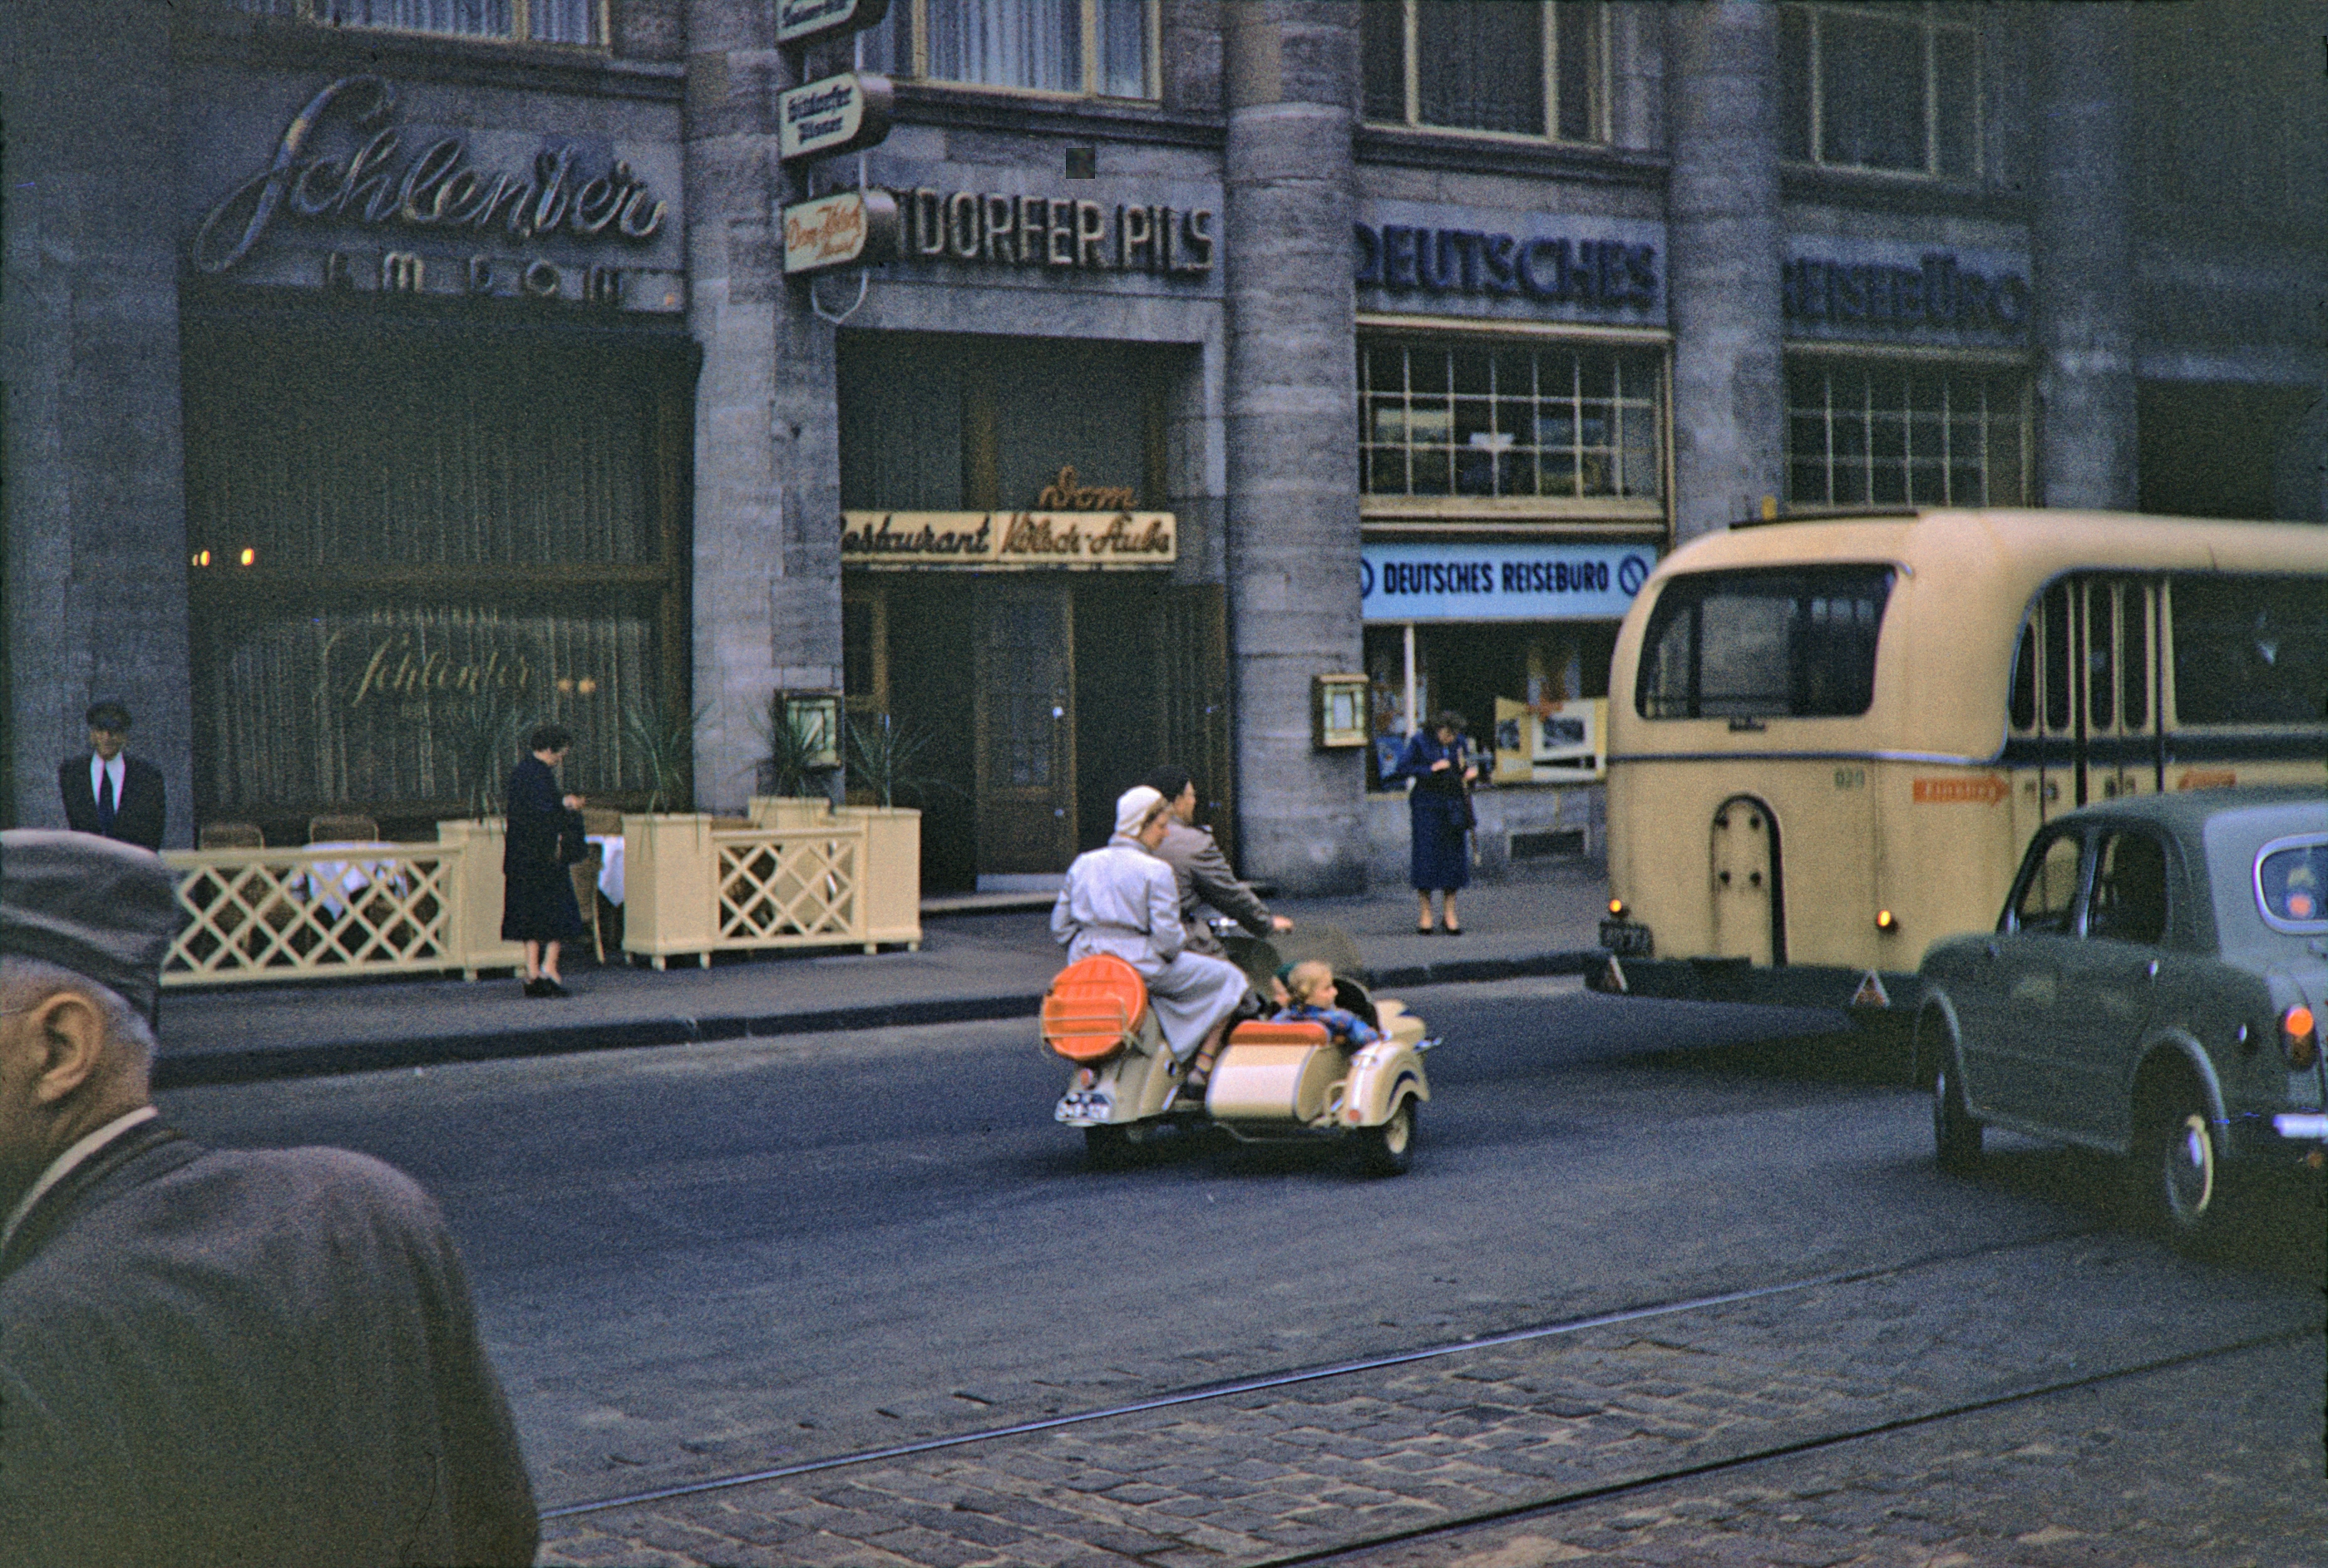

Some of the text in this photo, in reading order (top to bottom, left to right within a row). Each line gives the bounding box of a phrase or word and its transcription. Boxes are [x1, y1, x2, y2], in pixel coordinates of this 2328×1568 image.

[1123, 204, 1215, 271] PILS
[1354, 221, 1658, 306] DEUTSCHES
[841, 512, 990, 555] estaurant
[1383, 560, 1493, 595] DEUTSCHES
